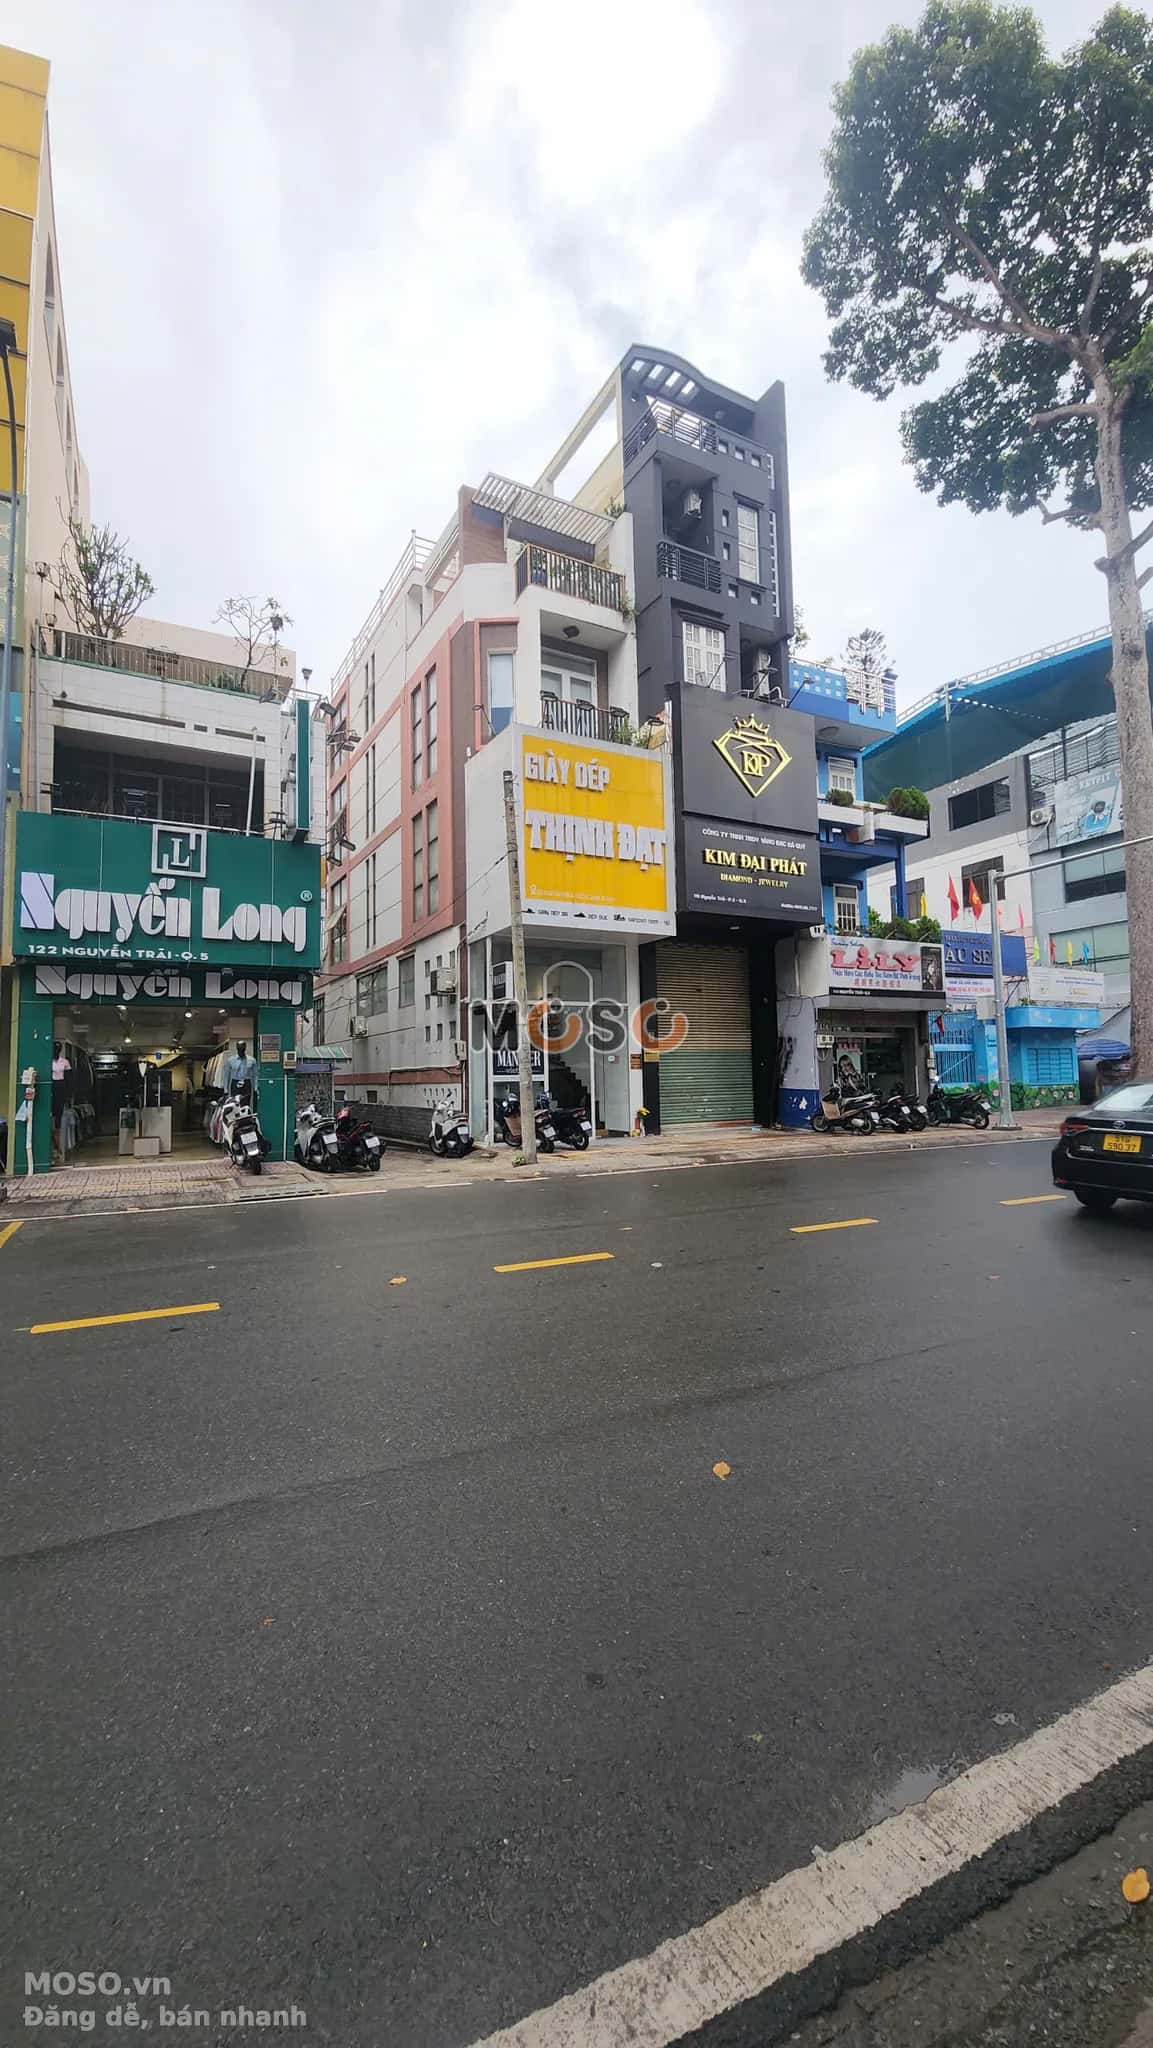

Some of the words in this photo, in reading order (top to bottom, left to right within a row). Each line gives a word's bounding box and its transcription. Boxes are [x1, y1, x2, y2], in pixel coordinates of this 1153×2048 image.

[525, 749, 570, 785] GIÀY
[525, 809, 614, 862] THỊNH
[617, 822, 666, 871] ĐẠT
[702, 828, 719, 837] CÔNG
[704, 848, 737, 867] KIM
[740, 853, 766, 873] ĐẠI
[769, 856, 808, 876] PHÁT
[720, 873, 753, 884] DIAMOND
[758, 877, 789, 888] JEWELRY
[202, 886, 307, 953] Long
[28, 944, 58, 954] 122
[62, 944, 132, 958] NGUYỄN
[944, 942, 968, 963] ÀU
[972, 948, 993, 965] SE
[205, 971, 302, 1005] Long
